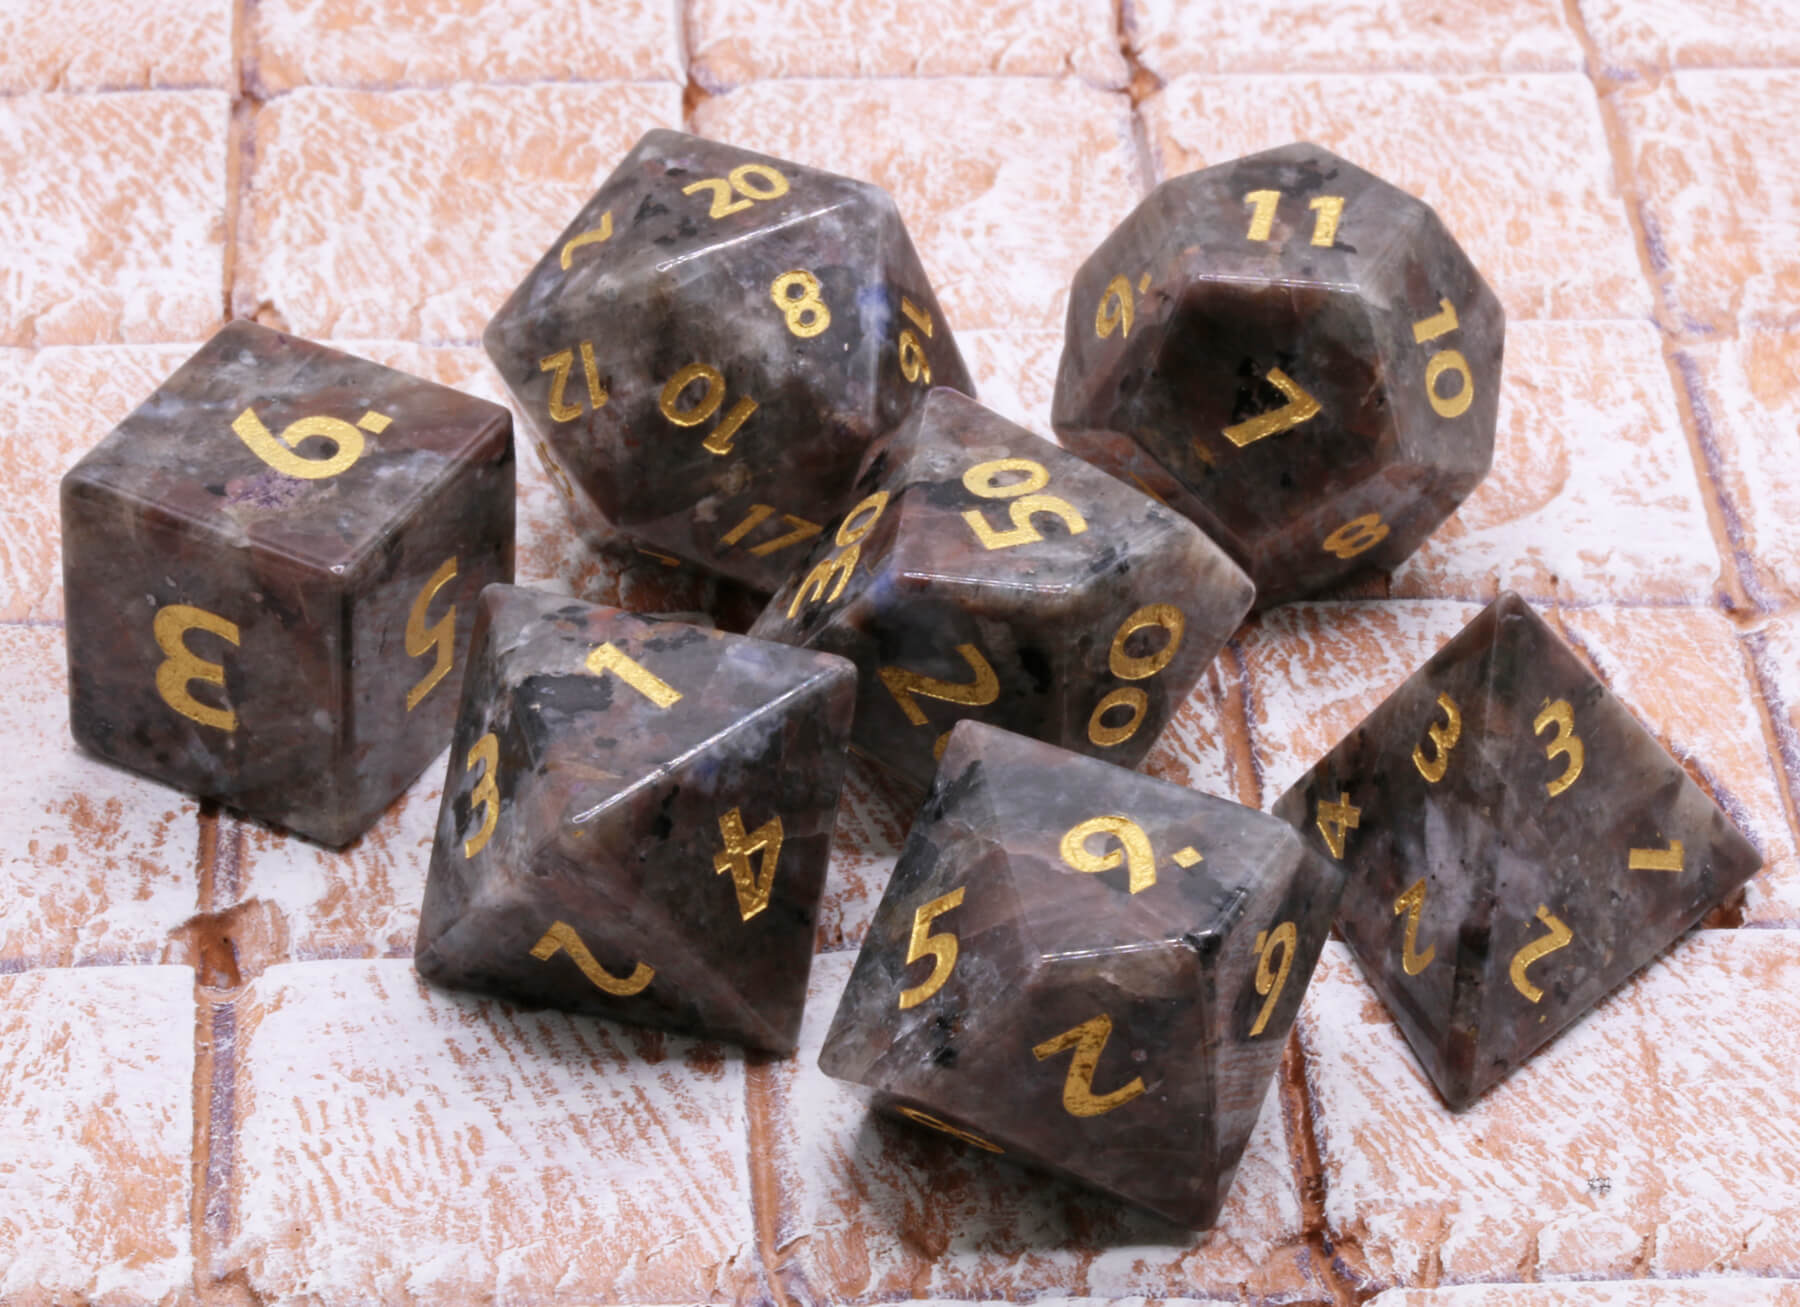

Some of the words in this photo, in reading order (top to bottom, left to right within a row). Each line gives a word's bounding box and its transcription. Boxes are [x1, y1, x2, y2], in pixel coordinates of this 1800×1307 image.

[682, 164, 790, 219] 20
[1244, 189, 1344, 247] 11
[771, 270, 830, 338] 8
[539, 341, 609, 423] 12
[1413, 298, 1474, 418] 10
[659, 363, 759, 455] 10
[1221, 367, 1321, 448] 7
[720, 505, 822, 557] 17
[961, 457, 1088, 549] 50
[1323, 513, 1390, 559] 8
[787, 490, 890, 618] 30
[153, 604, 240, 732] 3
[405, 556, 457, 712] 5
[585, 642, 683, 709] 1
[1088, 603, 1184, 746] 00
[1412, 692, 1462, 784] 3
[1534, 699, 1585, 798] 3
[465, 733, 499, 859] 3
[1316, 792, 1361, 860] 4
[713, 807, 784, 921] 4
[1628, 839, 1684, 872] 1
[529, 920, 656, 996] 2
[899, 886, 965, 1010] 5
[1394, 877, 1435, 976] 2
[1509, 904, 1573, 1003] 2
[1032, 1013, 1146, 1117] 2
